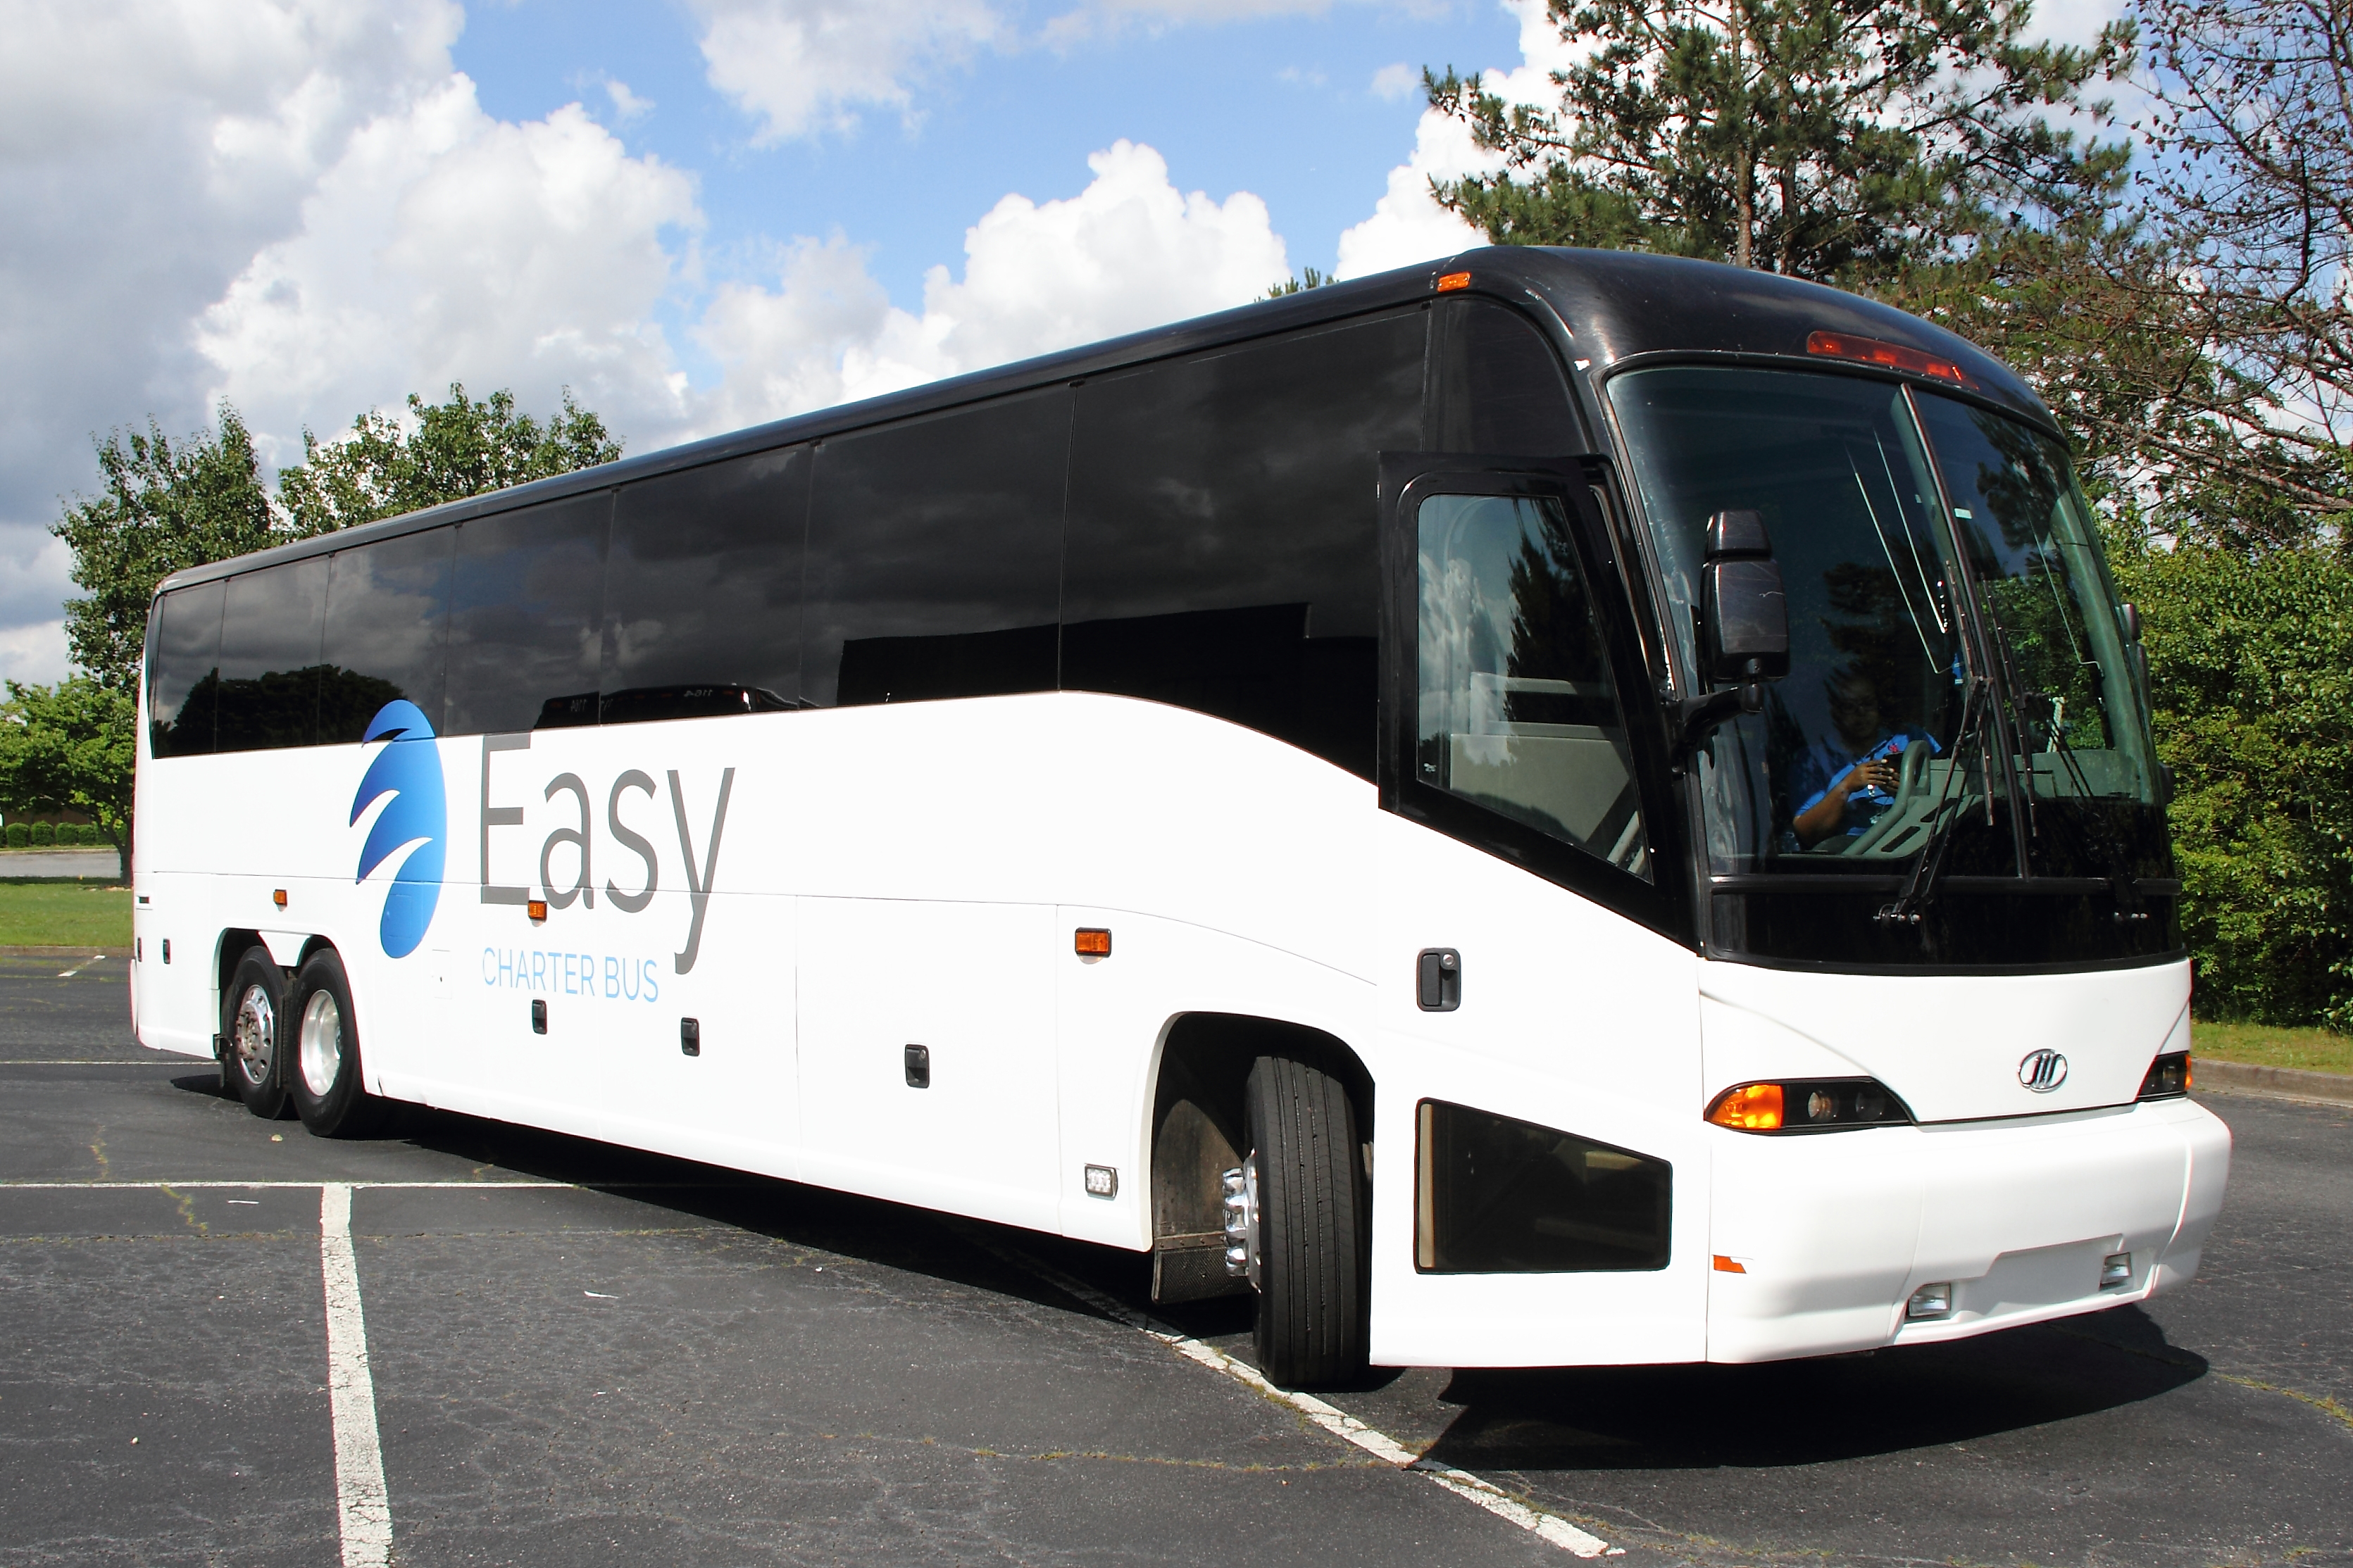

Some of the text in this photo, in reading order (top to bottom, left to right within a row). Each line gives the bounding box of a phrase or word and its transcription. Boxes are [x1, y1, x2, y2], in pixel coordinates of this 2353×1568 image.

[480, 733, 735, 974] Easy
[482, 947, 659, 1003] CHARTER BUS
